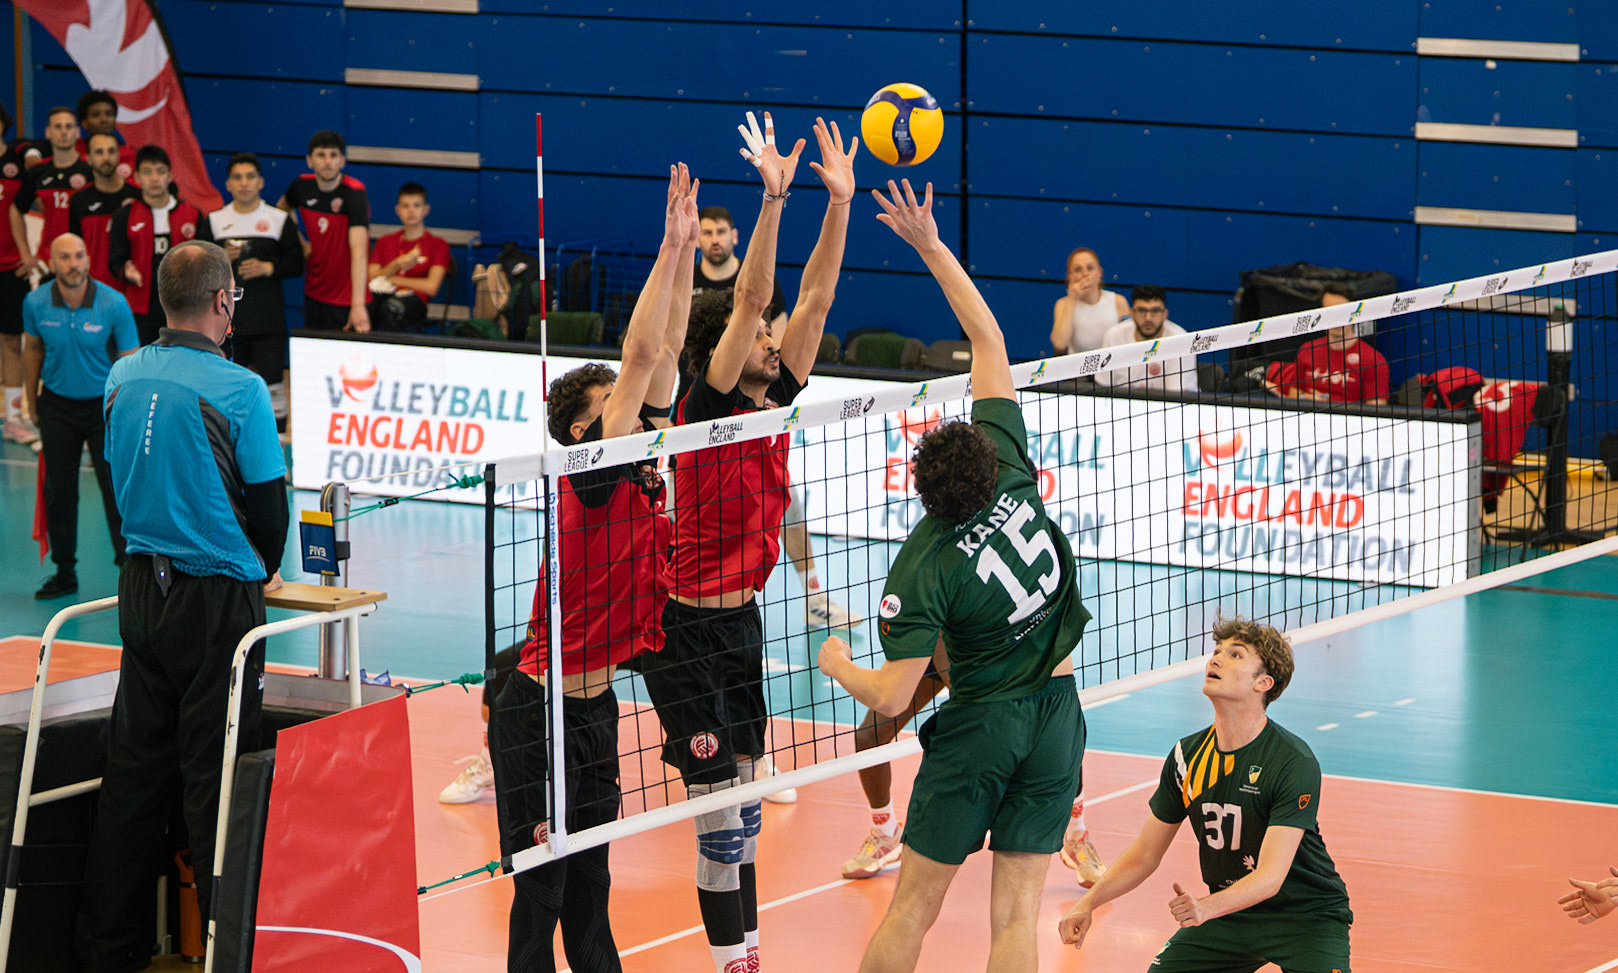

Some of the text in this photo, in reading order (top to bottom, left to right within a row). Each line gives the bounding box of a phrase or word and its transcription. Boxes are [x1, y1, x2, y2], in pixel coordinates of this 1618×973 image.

[53, 191, 69, 208] 12
[318, 217, 329, 233] 9
[1084, 354, 1101, 365] SUPER
[1080, 363, 1099, 374] LEAGUE
[843, 397, 863, 410] SUPER
[839, 407, 861, 420] LEAGUE
[145, 393, 159, 455] REFEREE
[327, 412, 484, 455] ENGLAND
[708, 432, 736, 445] ENGLAND
[567, 448, 589, 462] SUPER
[564, 459, 588, 473] LEAGUE
[1181, 481, 1364, 528] ENGLAND
[956, 492, 1019, 558] KANE
[308, 545, 327, 557] FIVB
[1178, 520, 1416, 573] FOUNDATION
[975, 498, 1061, 625] 15
[1201, 802, 1242, 851] 37
